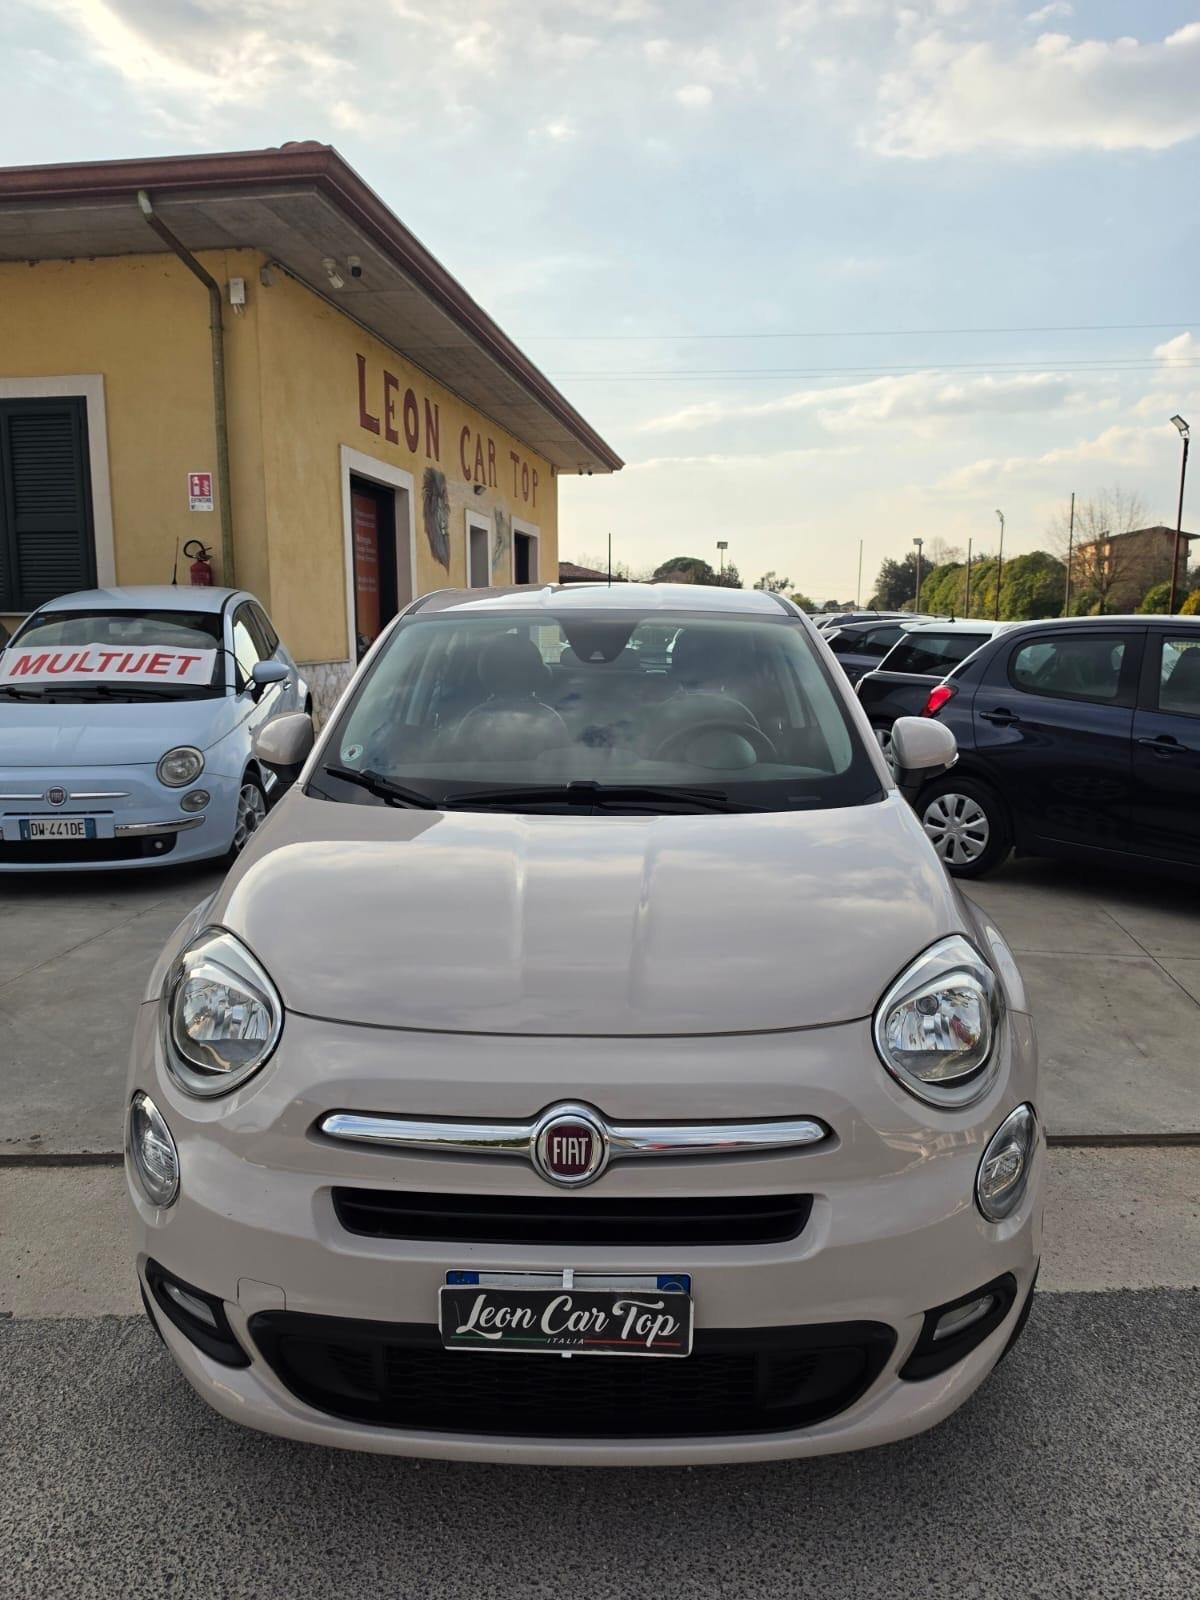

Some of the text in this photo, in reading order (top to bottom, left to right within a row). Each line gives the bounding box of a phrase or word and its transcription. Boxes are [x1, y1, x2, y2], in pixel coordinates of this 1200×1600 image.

[356, 353, 539, 508] LEON CAR TOP
[9, 651, 201, 676] MULTIJET
[553, 1137, 589, 1165] FIAT
[455, 1294, 680, 1347] Leon Car Top
[546, 1337, 584, 1345] ITALIA
